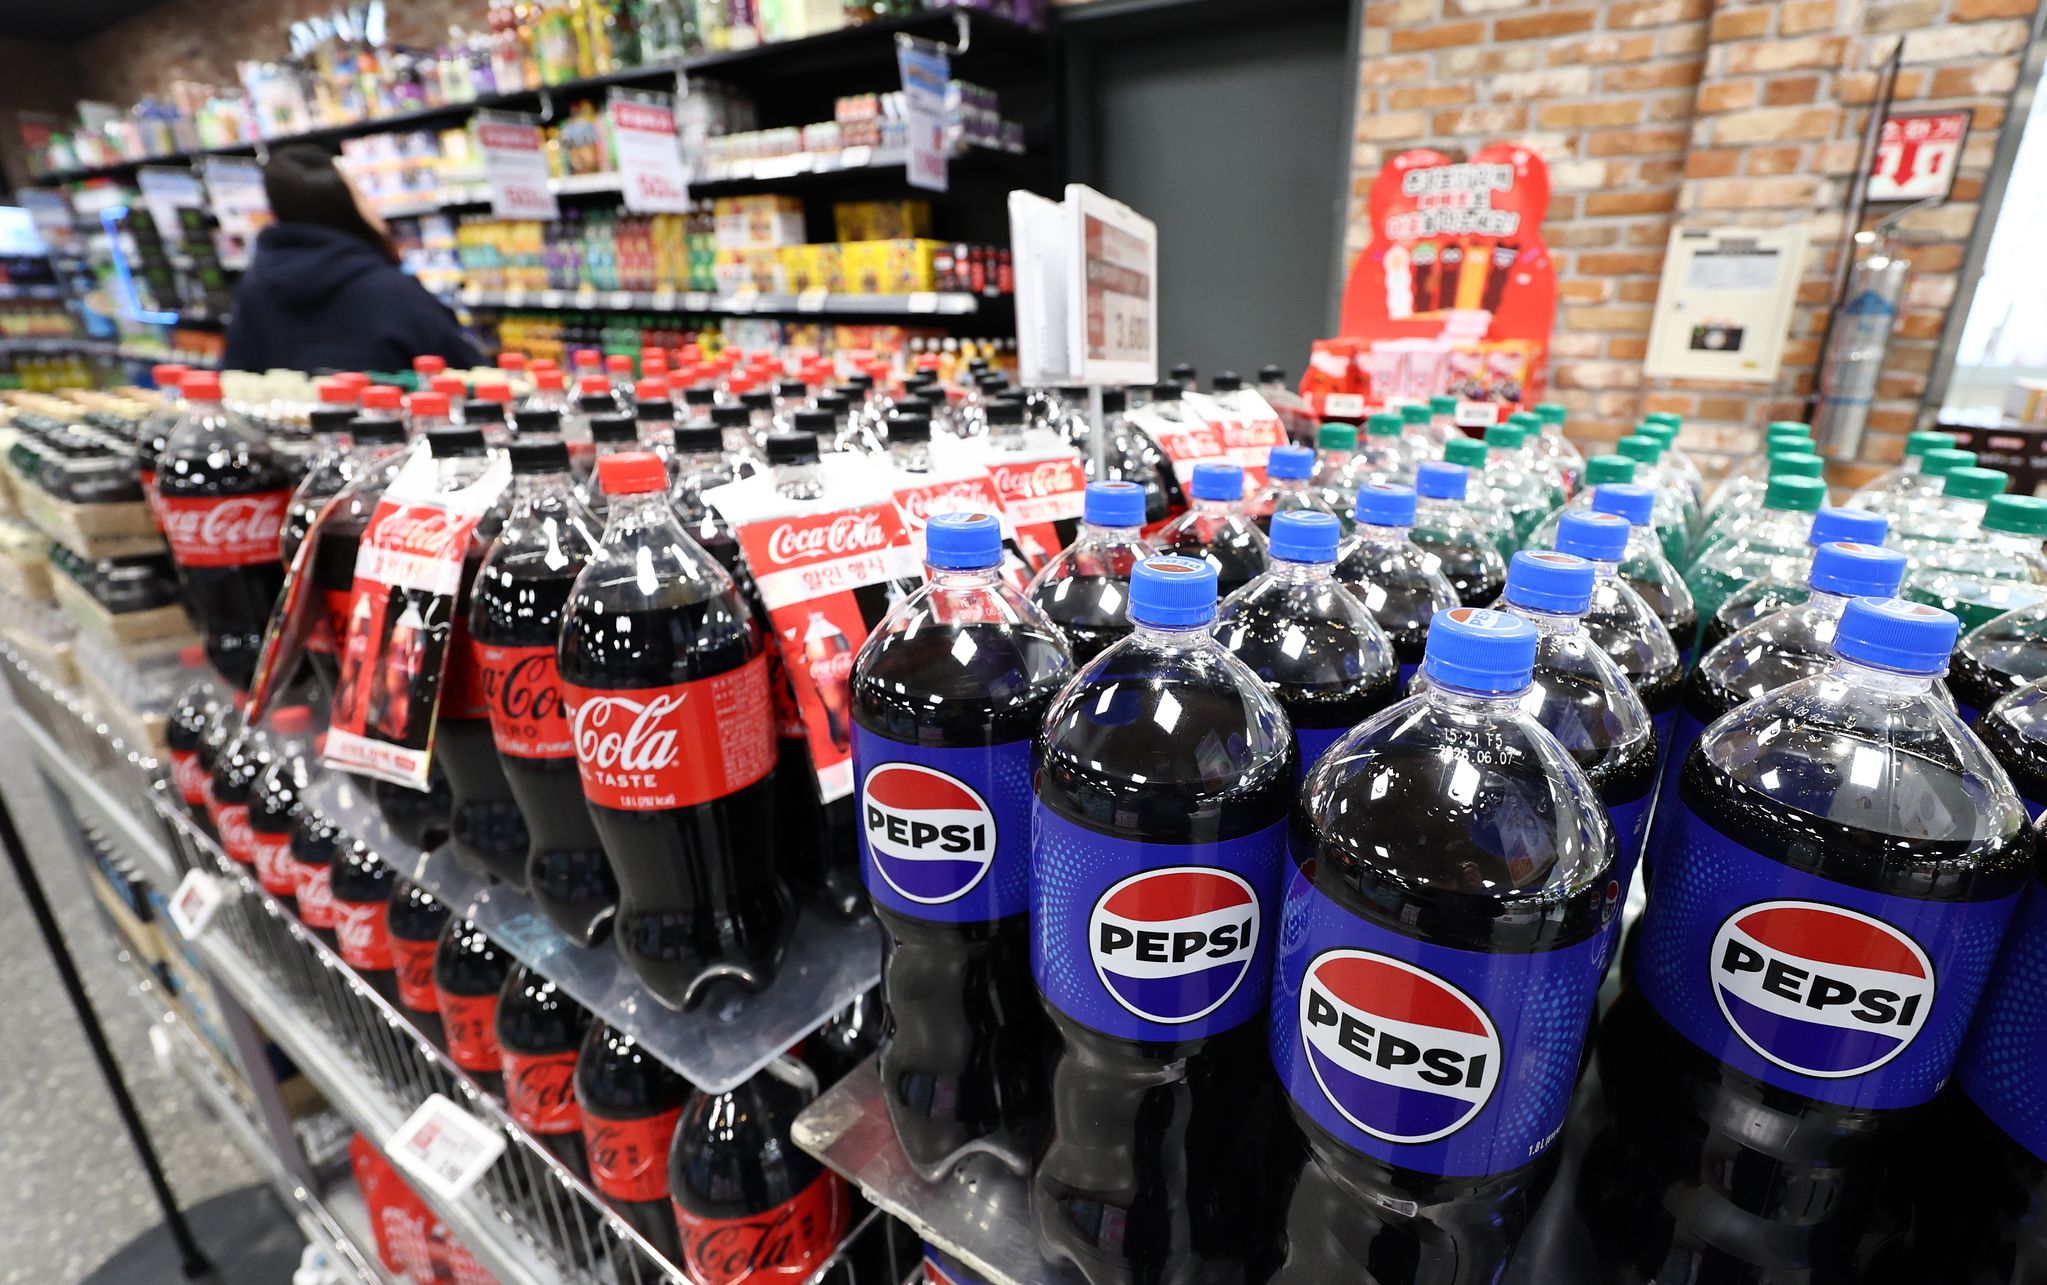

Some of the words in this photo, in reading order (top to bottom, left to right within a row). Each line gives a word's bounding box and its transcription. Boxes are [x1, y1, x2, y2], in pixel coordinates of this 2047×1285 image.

[768, 511, 886, 565] Coca-Cola
[803, 566, 843, 592] 할인
[848, 555, 886, 582] 행사
[1486, 732, 1503, 749] F5
[595, 771, 658, 789] TASTE
[867, 803, 986, 852] PEPSI
[1100, 916, 1252, 963] PEPSI
[1721, 937, 1923, 1026] PEPSI
[1307, 987, 1488, 1088] PEPSI
